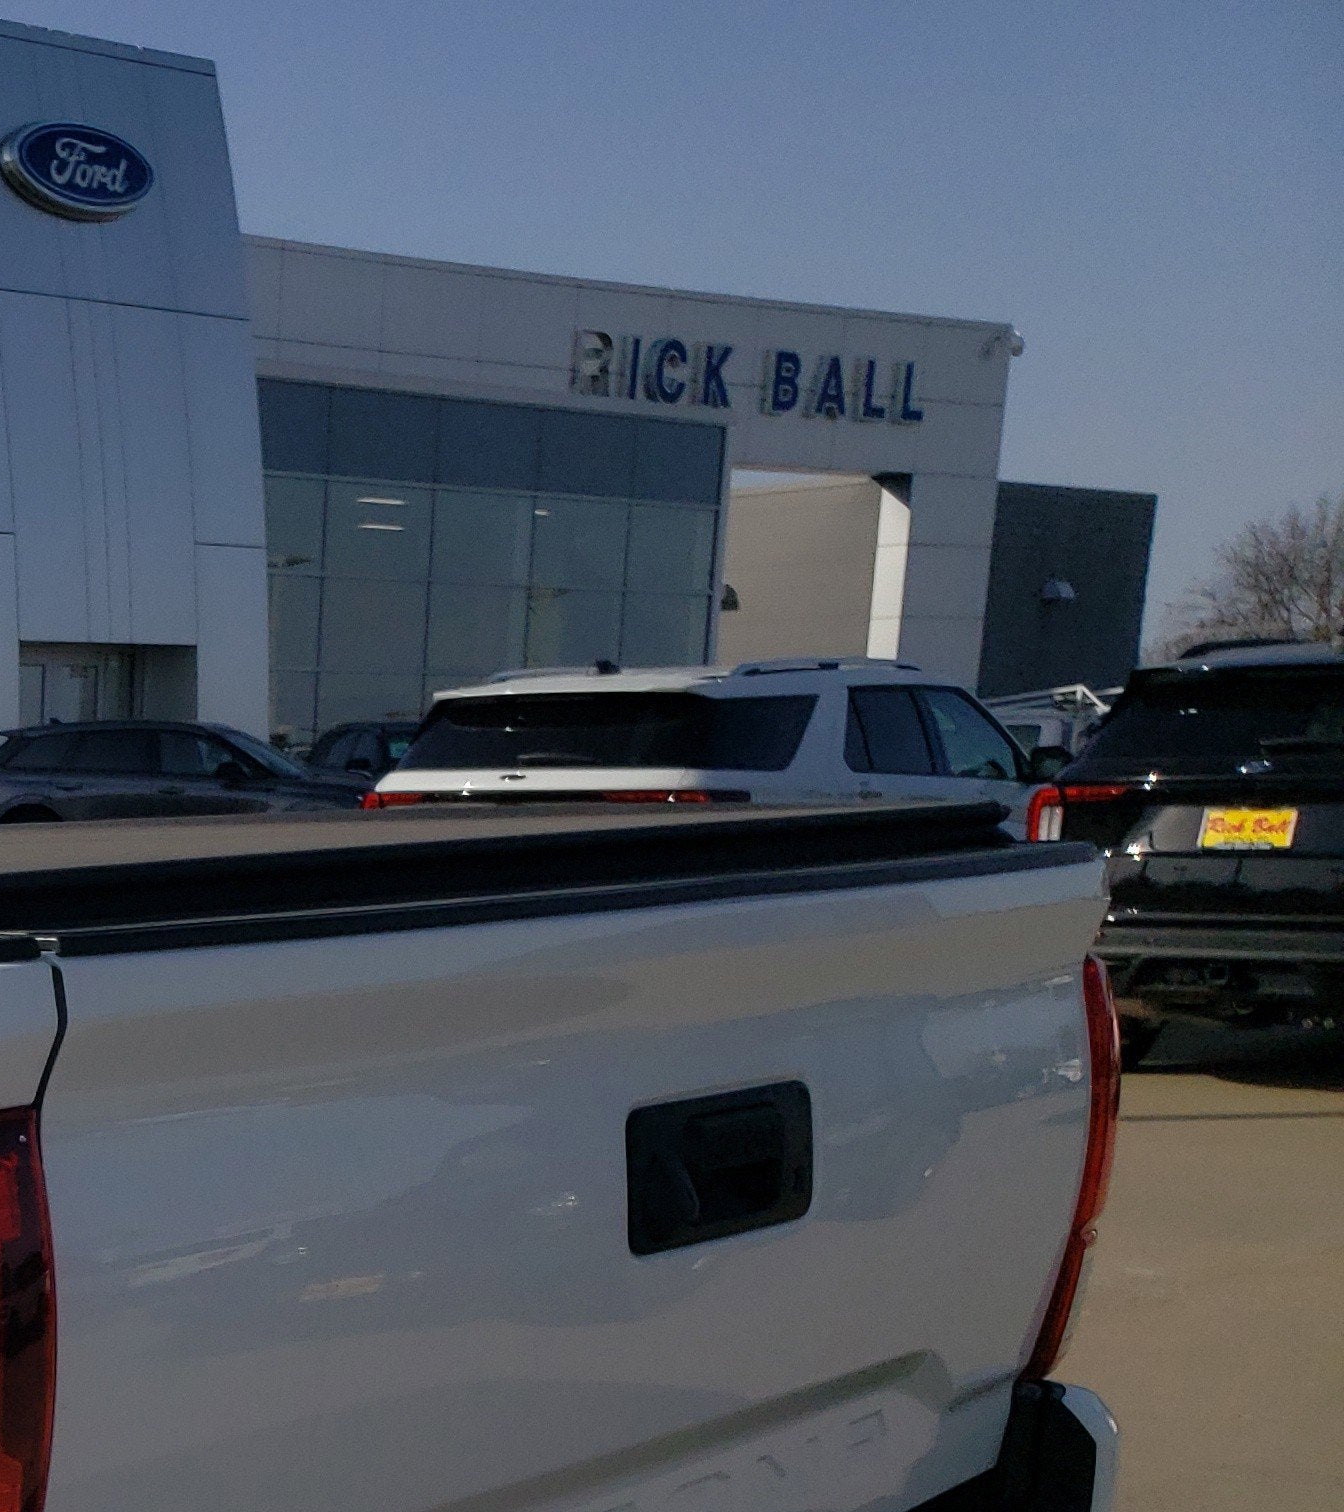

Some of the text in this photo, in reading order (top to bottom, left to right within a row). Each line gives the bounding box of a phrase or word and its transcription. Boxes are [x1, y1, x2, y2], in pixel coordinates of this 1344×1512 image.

[50, 138, 128, 193] Ford
[570, 329, 924, 424] RICK BALL
